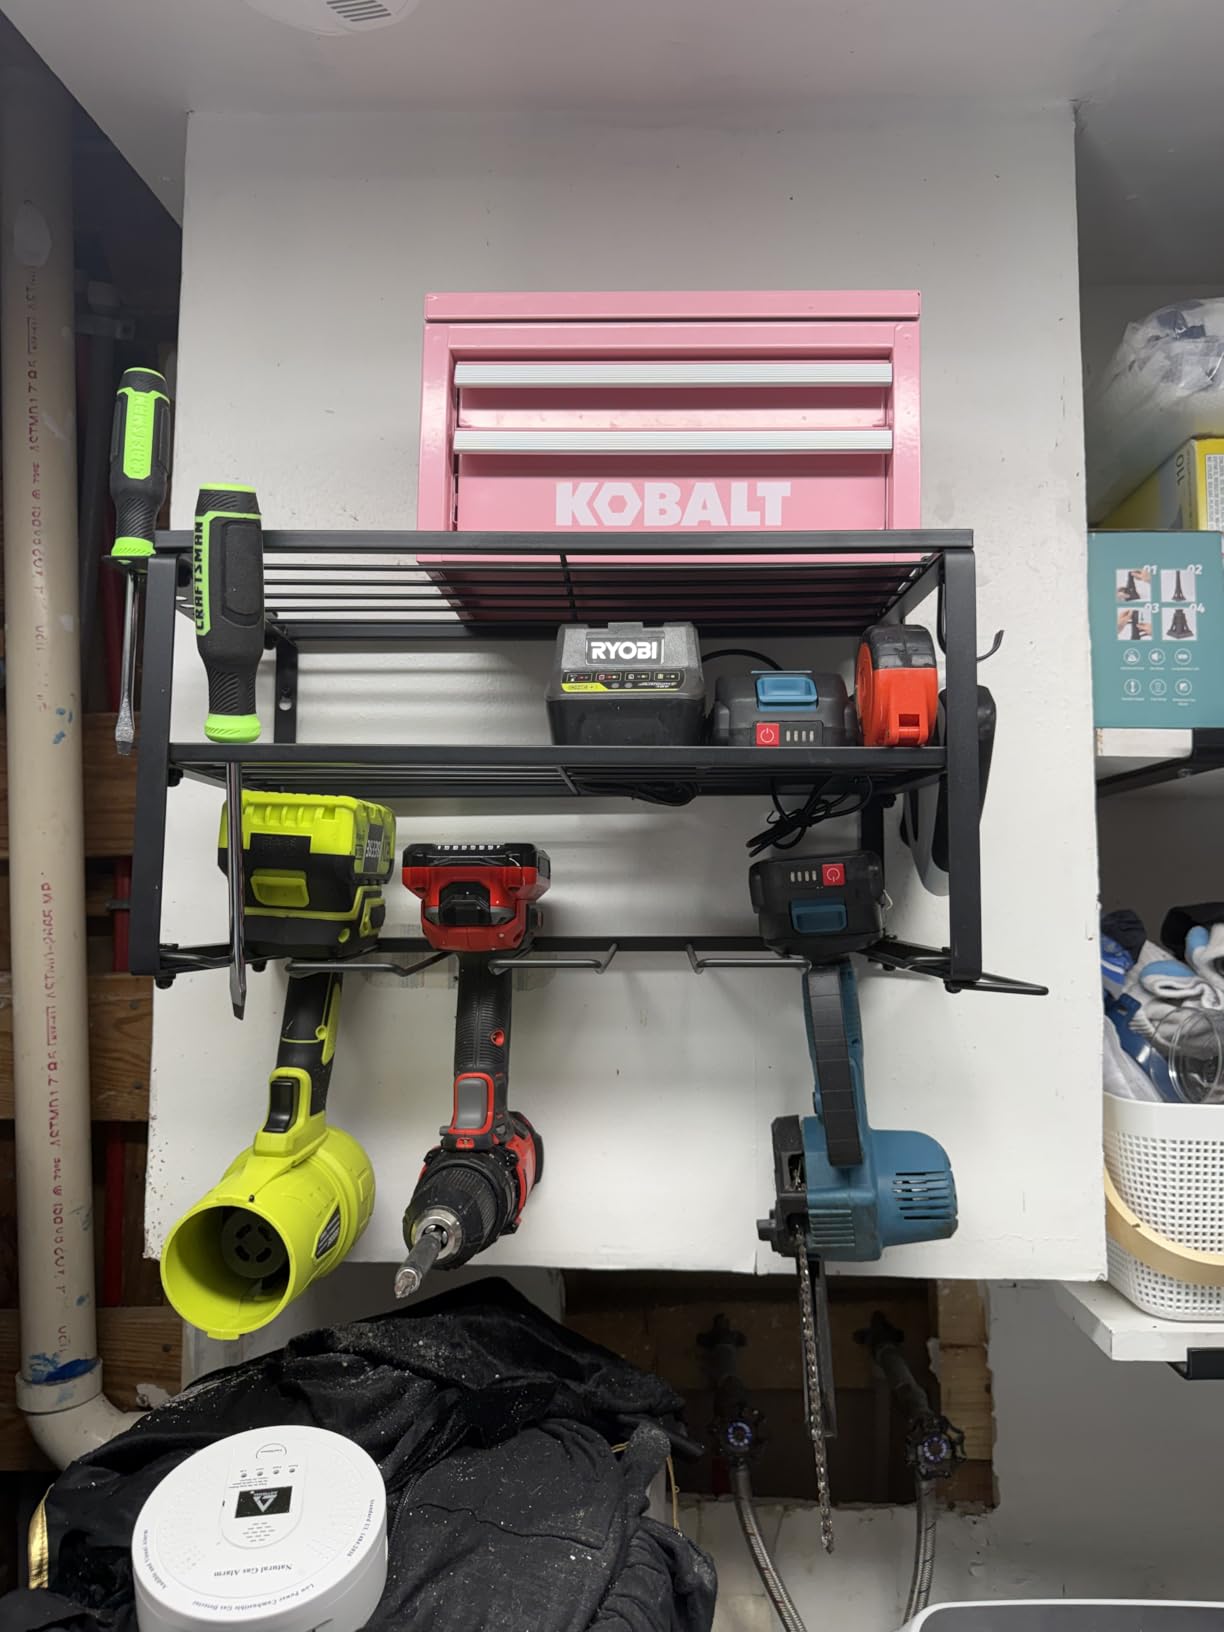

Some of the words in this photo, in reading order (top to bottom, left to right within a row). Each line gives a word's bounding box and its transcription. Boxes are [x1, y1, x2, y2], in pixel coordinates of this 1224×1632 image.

[556, 481, 792, 527] KOBALT
[194, 521, 204, 632] CRAFTSMAN
[590, 641, 658, 660] RYOBI
[213, 1568, 240, 1578] Alarm
[242, 1566, 258, 1575] Gas
[261, 1563, 293, 1575] Natural
